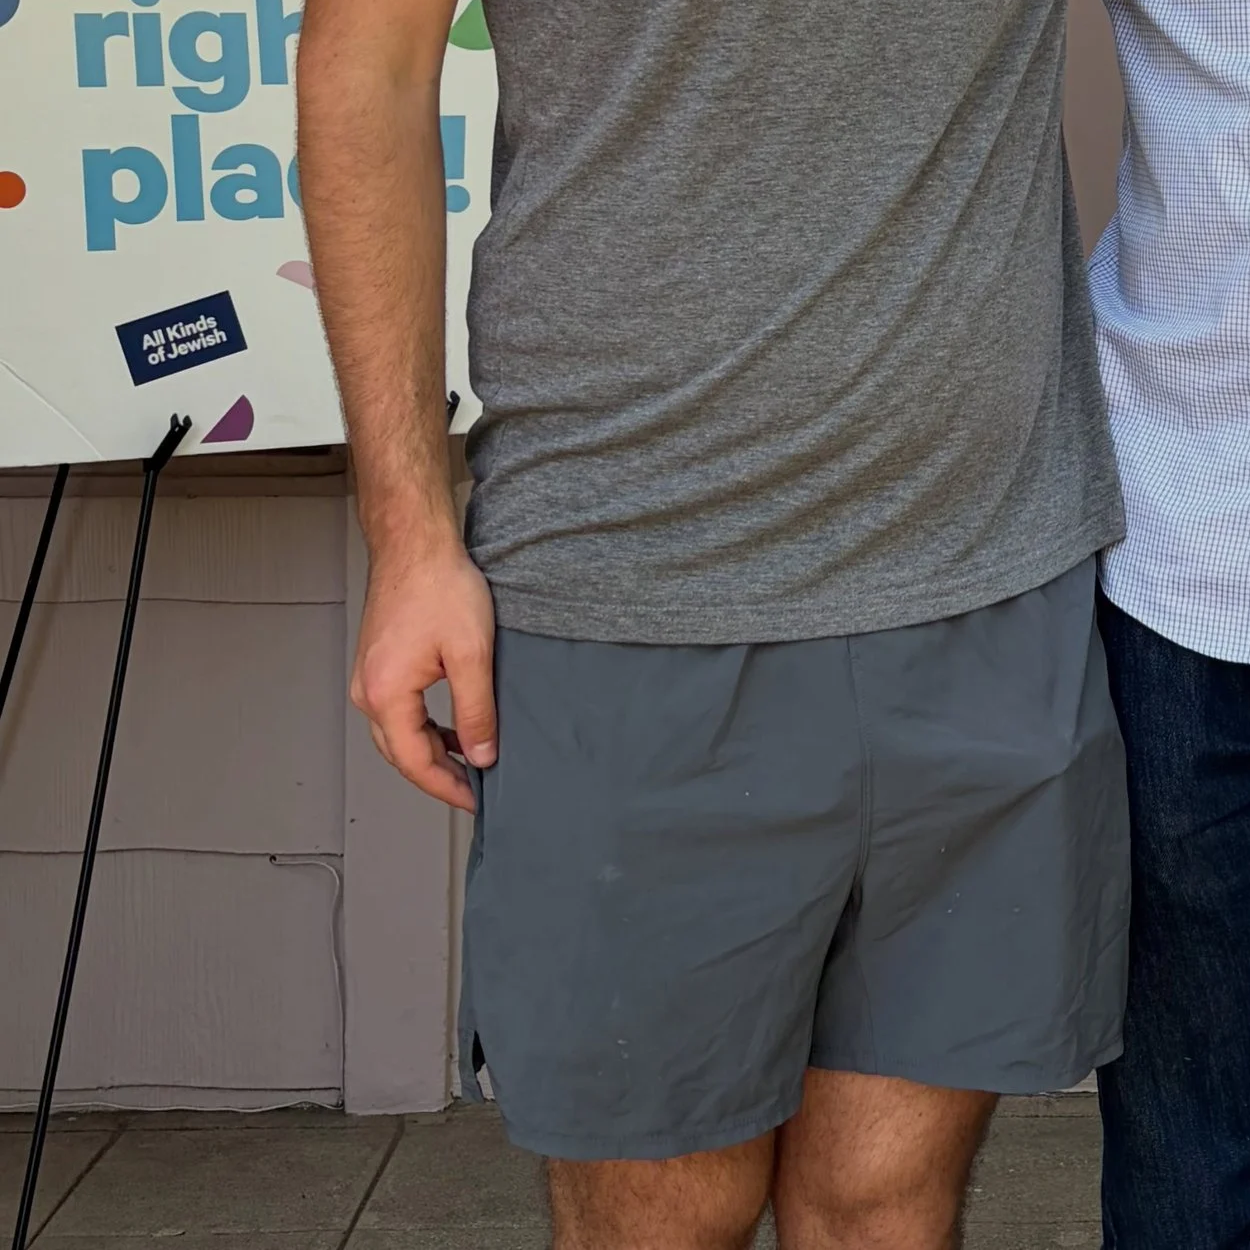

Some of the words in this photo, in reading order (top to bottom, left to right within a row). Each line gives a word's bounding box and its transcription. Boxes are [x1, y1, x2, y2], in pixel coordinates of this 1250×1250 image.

[82, 114, 471, 251] pla!
[142, 329, 166, 350] All
[165, 314, 217, 342] Kinds
[147, 346, 166, 365] of
[167, 328, 228, 359] Jewish
